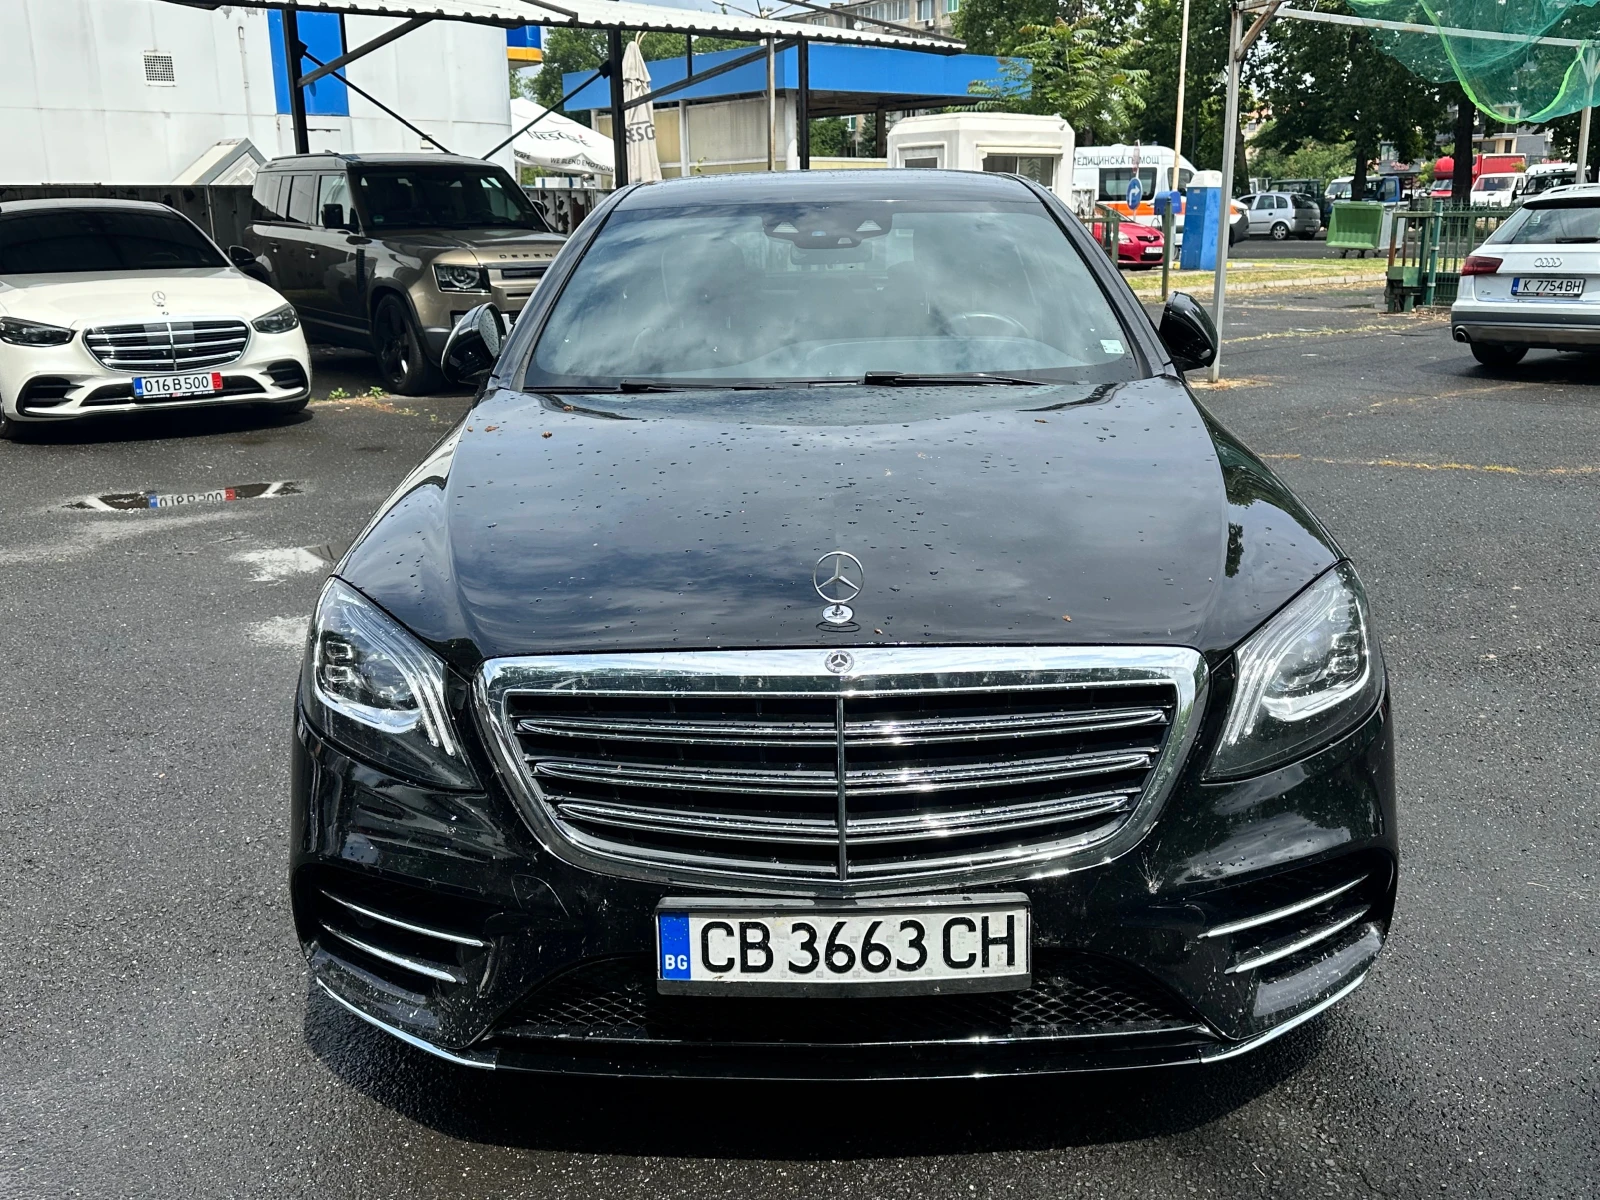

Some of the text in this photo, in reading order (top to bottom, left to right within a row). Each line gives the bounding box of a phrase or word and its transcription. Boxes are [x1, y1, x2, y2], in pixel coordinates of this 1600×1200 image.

[561, 158, 580, 166] BLEND
[582, 160, 614, 172] EMOTIONS
[1523, 280, 1531, 291] K
[701, 914, 1015, 974] CB 3663 CH
[664, 954, 688, 970] BG
